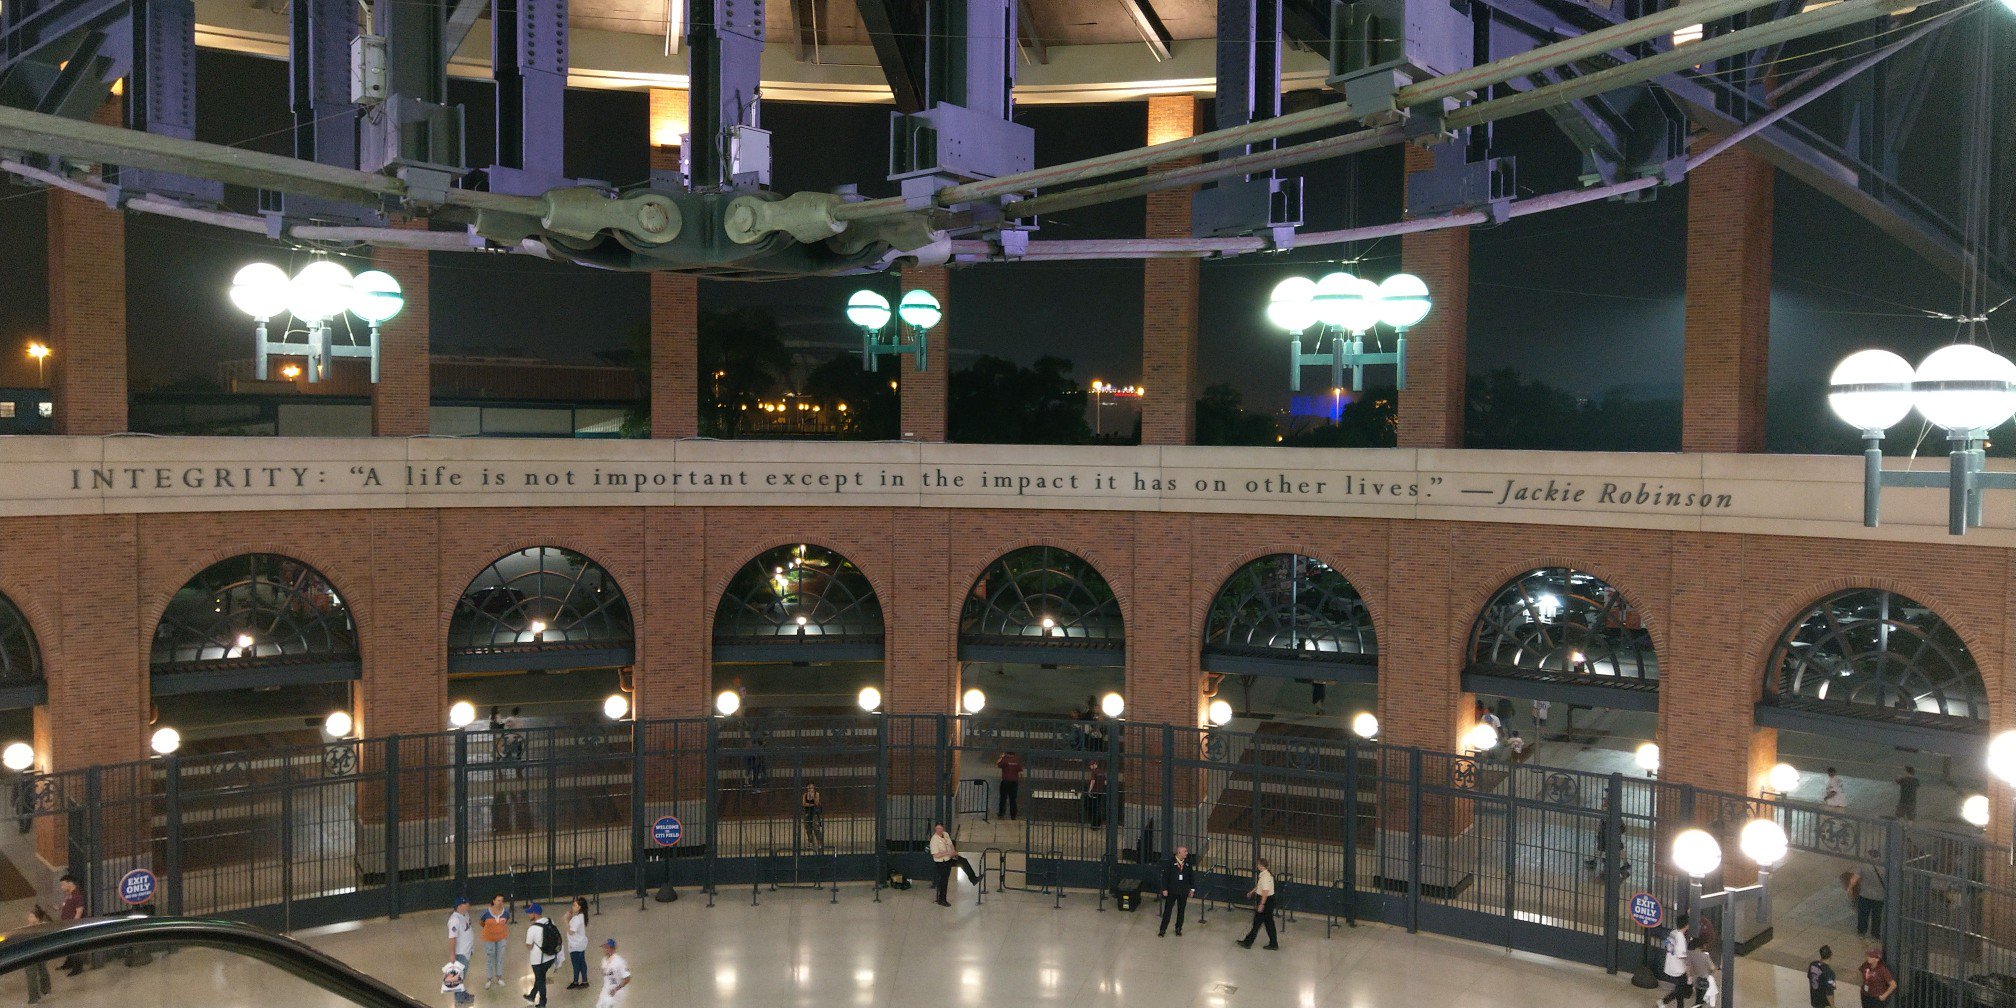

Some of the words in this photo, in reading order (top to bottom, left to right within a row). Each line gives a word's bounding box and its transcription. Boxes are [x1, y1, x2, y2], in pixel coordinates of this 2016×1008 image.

[70, 467, 327, 490] INTEGRITY:
[404, 464, 462, 487] life
[481, 468, 507, 487] is
[524, 470, 576, 487] not
[593, 468, 748, 492] important
[765, 471, 864, 493] except
[880, 469, 905, 488] in
[918, 468, 964, 488] the
[981, 471, 1079, 496] impact
[1095, 473, 1117, 490] it
[1133, 471, 1177, 491] has
[1194, 479, 1228, 493] on
[1245, 472, 1328, 495] other
[1345, 475, 1446, 498] lives.”
[1597, 481, 1734, 509] Robinson
[128, 875, 149, 886] EXIT
[126, 883, 151, 894] ONLY
[1636, 898, 1656, 909] EXIT
[1634, 905, 1657, 917] ONLY
